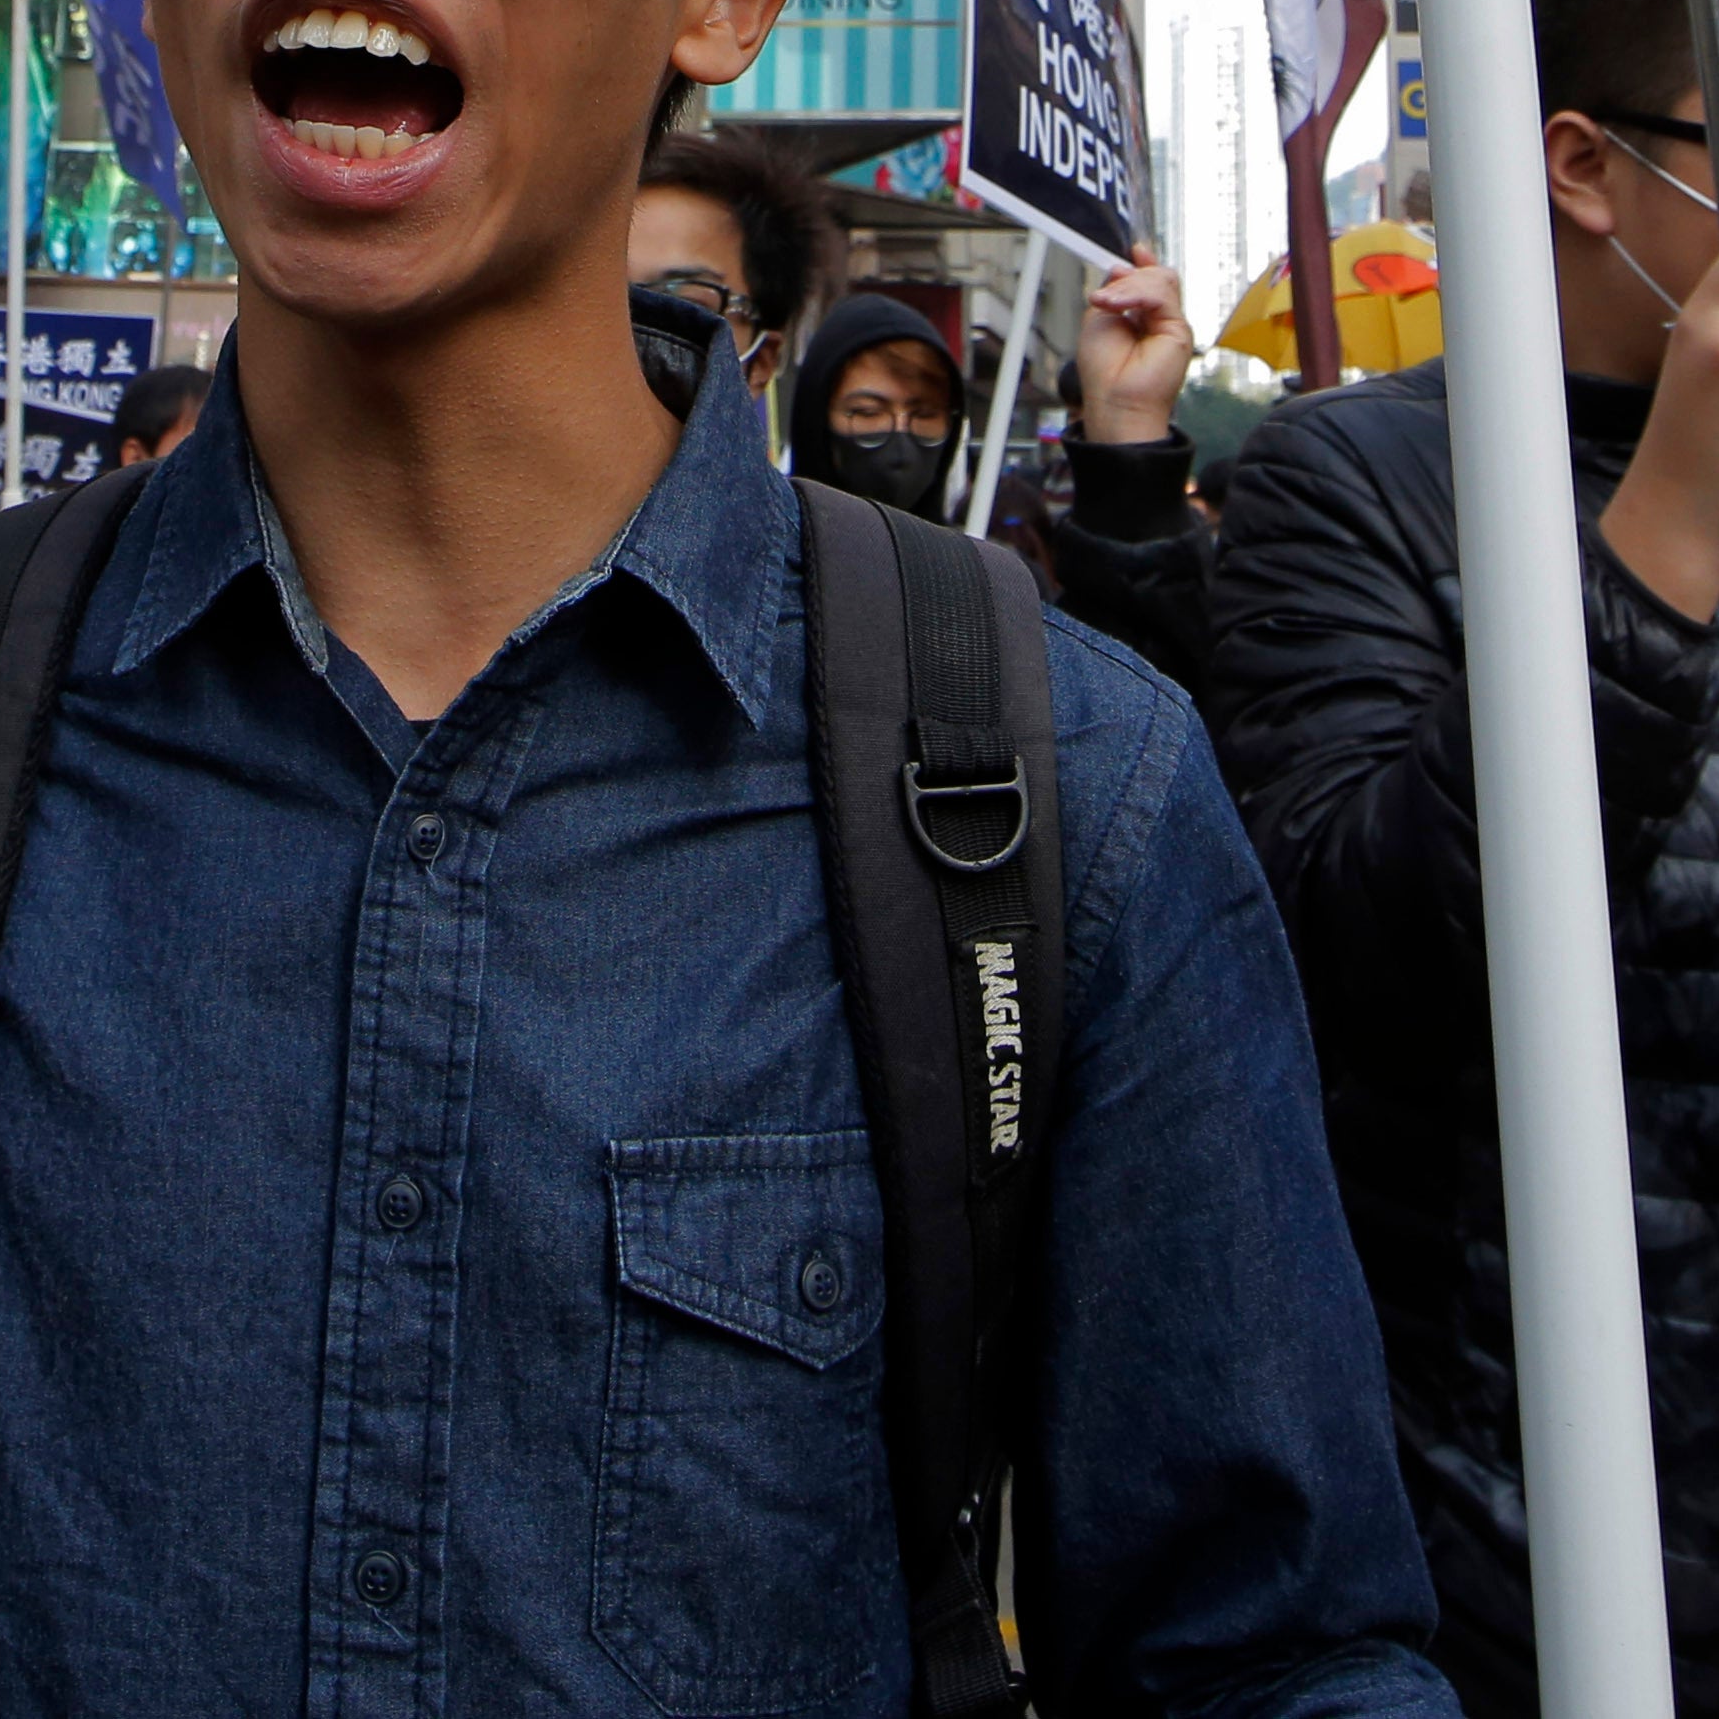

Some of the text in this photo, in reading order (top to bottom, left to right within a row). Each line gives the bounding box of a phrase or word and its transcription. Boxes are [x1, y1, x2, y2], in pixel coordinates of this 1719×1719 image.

[1037, 21, 1121, 146] HONG
[974, 941, 1024, 1155] MAGIC STAR
